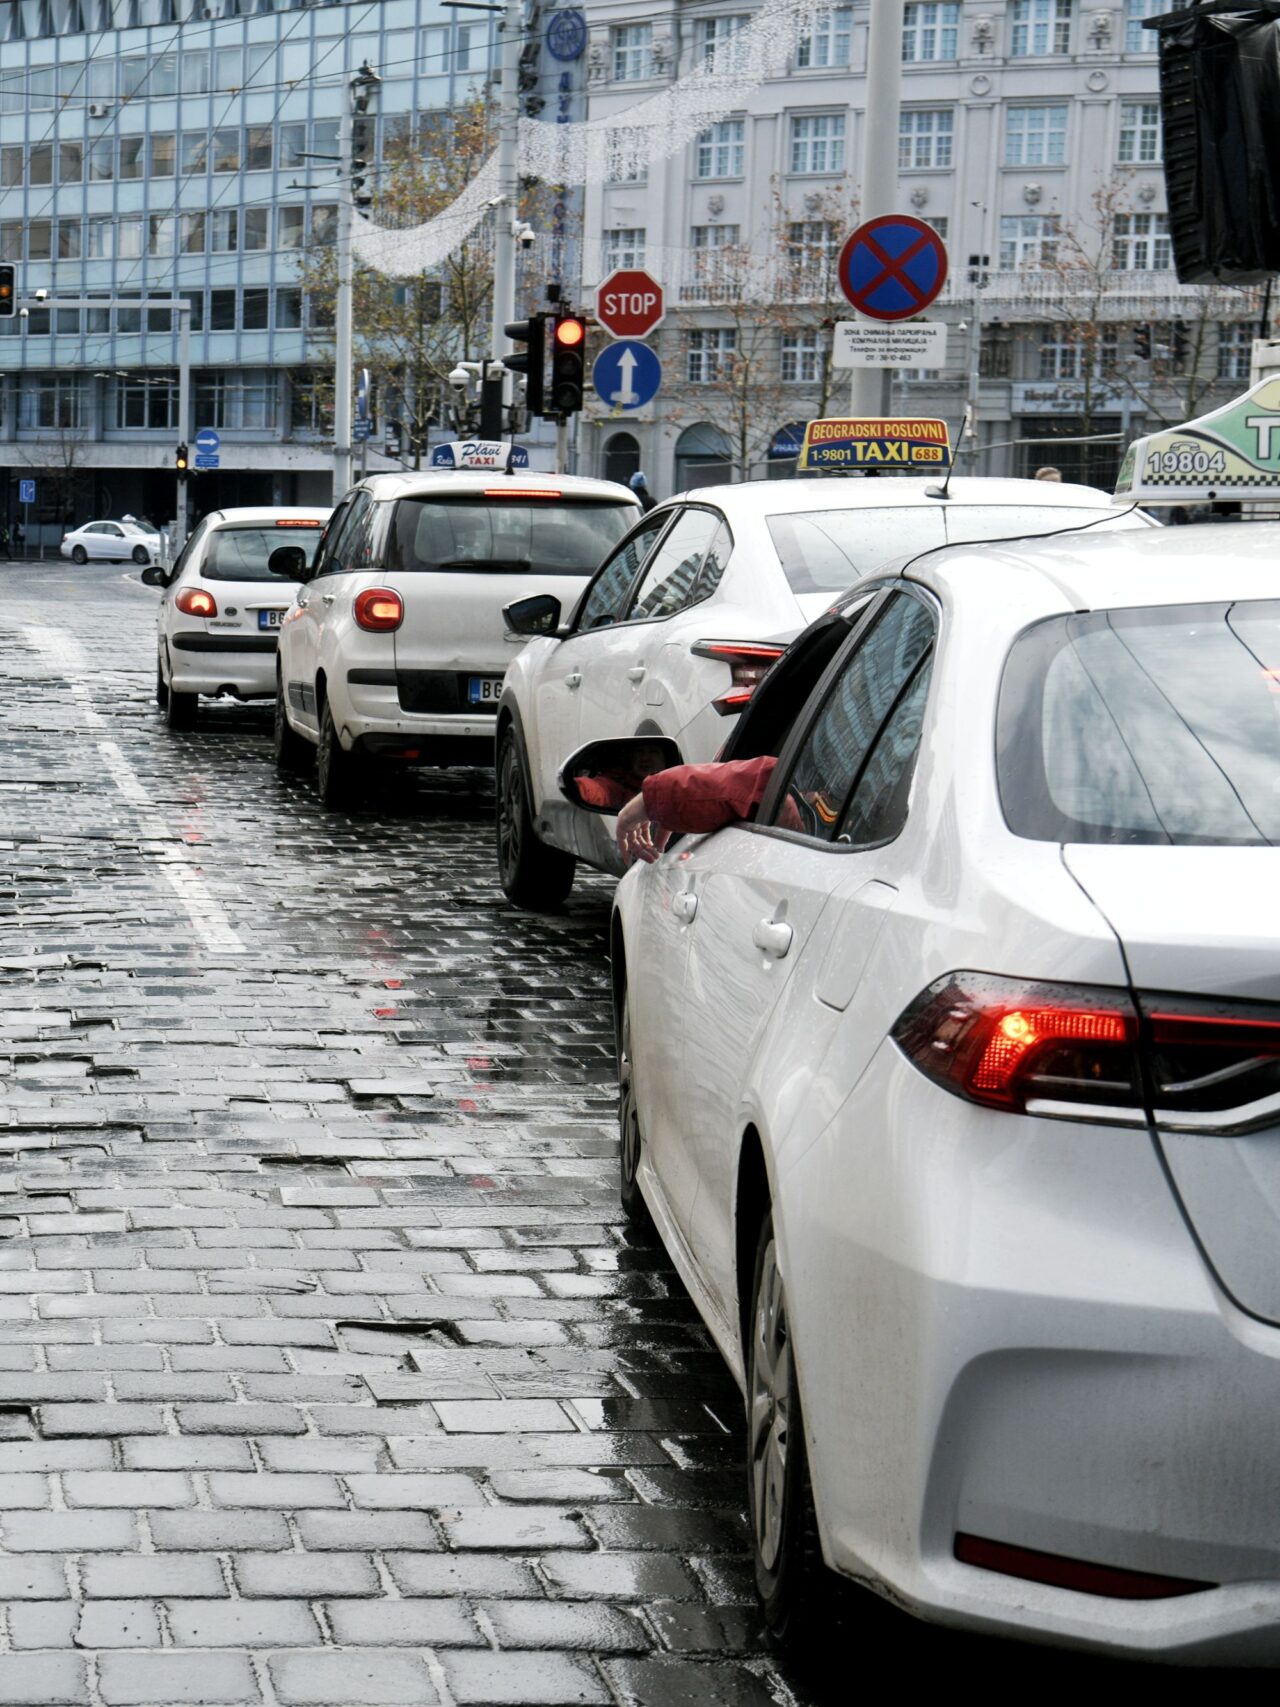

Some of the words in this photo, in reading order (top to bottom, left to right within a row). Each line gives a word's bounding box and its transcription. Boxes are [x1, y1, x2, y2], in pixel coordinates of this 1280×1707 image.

[605, 293, 656, 315] STOP
[812, 424, 881, 440] BEOGRADSKI
[884, 423, 943, 439] POSLOVNI
[1245, 415, 1280, 460] T
[461, 443, 502, 460] Plavi
[811, 449, 851, 461] 1-9801
[851, 441, 909, 461] TAXI
[915, 448, 939, 460] 688
[1148, 450, 1226, 473] 19804
[482, 681, 503, 699] BG
